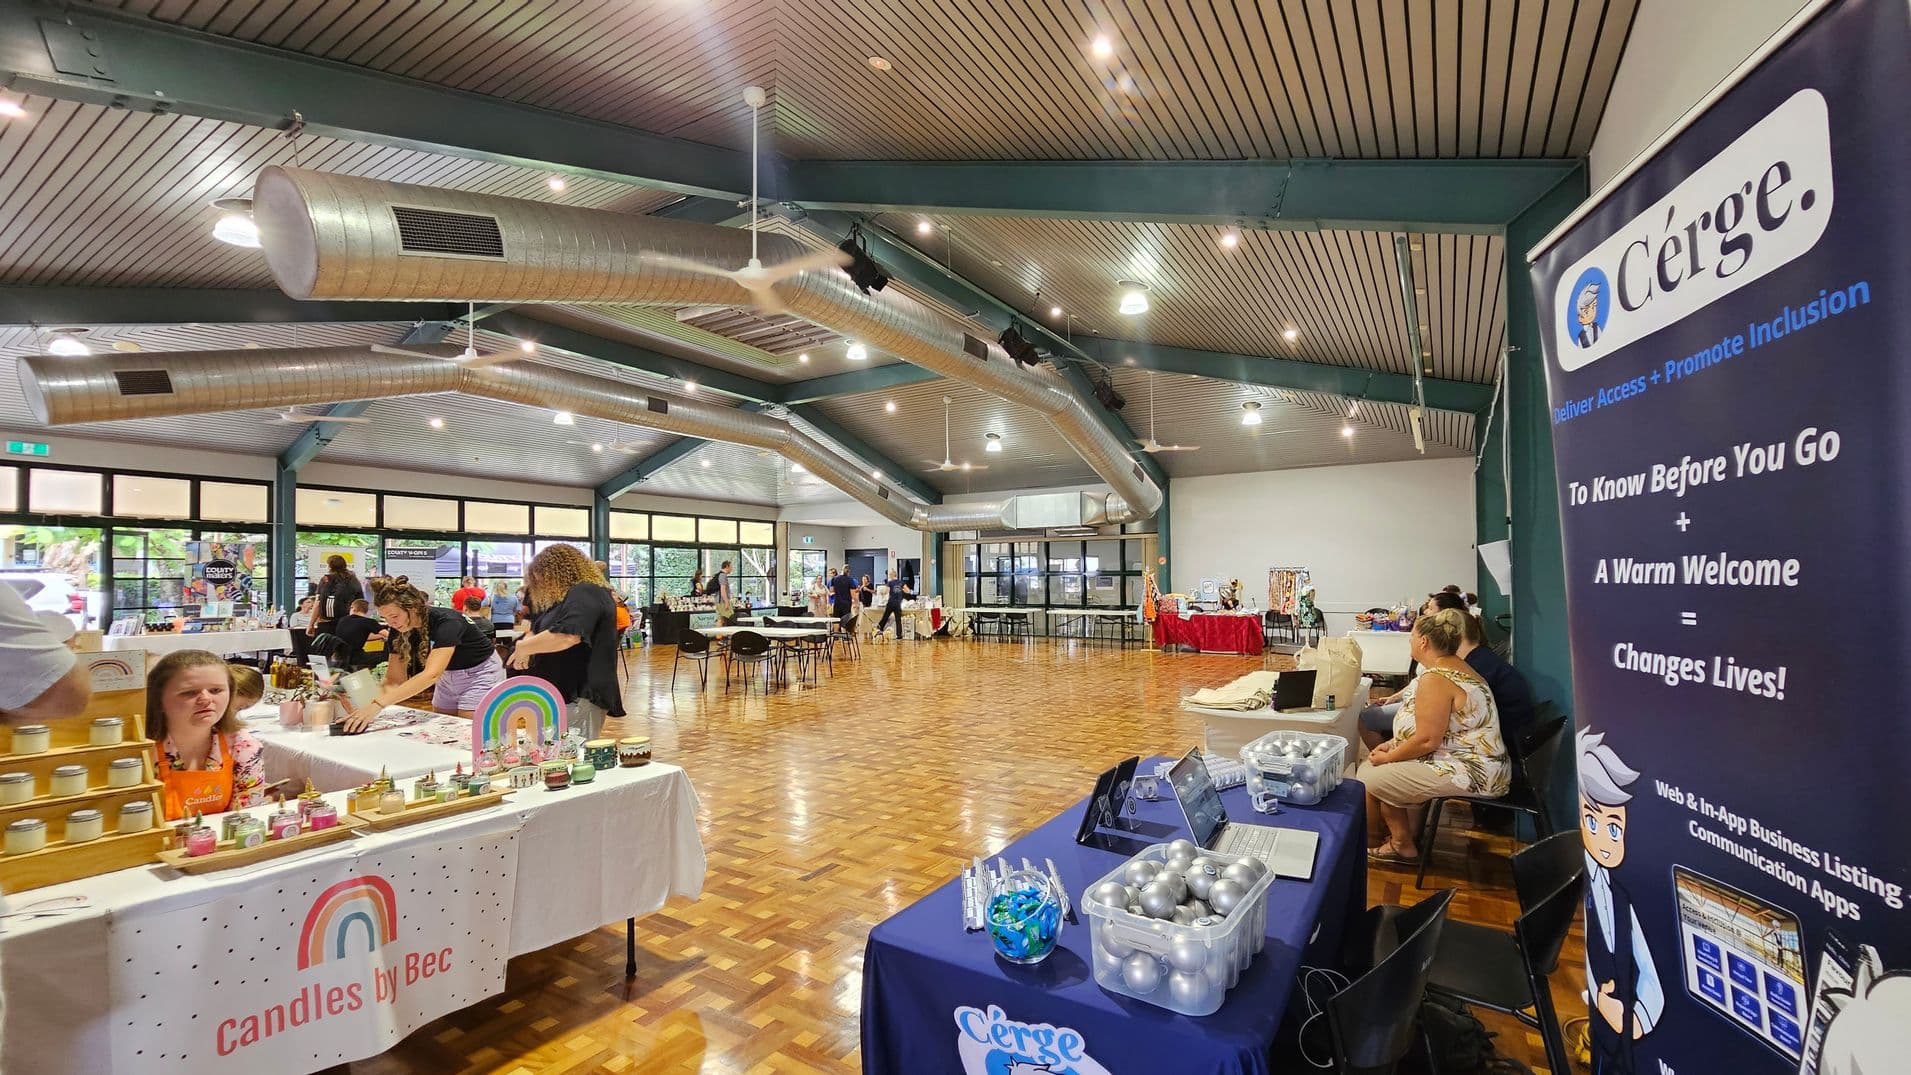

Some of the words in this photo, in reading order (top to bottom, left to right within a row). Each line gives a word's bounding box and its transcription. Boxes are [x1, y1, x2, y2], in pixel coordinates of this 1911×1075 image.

[1616, 160, 1816, 313] Cérge.
[1554, 396, 1594, 425] Deliver
[1597, 373, 1647, 408] Access
[1664, 333, 1744, 383] Promote
[1749, 281, 1871, 349] Inclusion
[1569, 482, 1588, 506] To
[1592, 471, 1646, 503] Know
[1650, 454, 1726, 497] Before
[1734, 441, 1785, 478] You
[1795, 427, 1841, 466] Go
[205, 567, 234, 575] EQUITY
[1594, 559, 1609, 584] A
[1613, 558, 1675, 584] Warm
[1682, 552, 1800, 587] Welcome
[1614, 643, 1706, 687] Changes
[1712, 656, 1787, 700] Lives!
[1655, 779, 1685, 805] Web
[1687, 793, 1698, 811] &
[1700, 798, 1747, 835] In-App
[1750, 818, 1820, 867] Business
[1824, 852, 1903, 909] Listing
[1689, 820, 1807, 894] Communication
[1811, 881, 1861, 921] Apps
[216, 982, 363, 1058] Candles
[373, 966, 399, 1005] by
[404, 946, 454, 987] Bec
[960, 1010, 1082, 1066] Cérge
